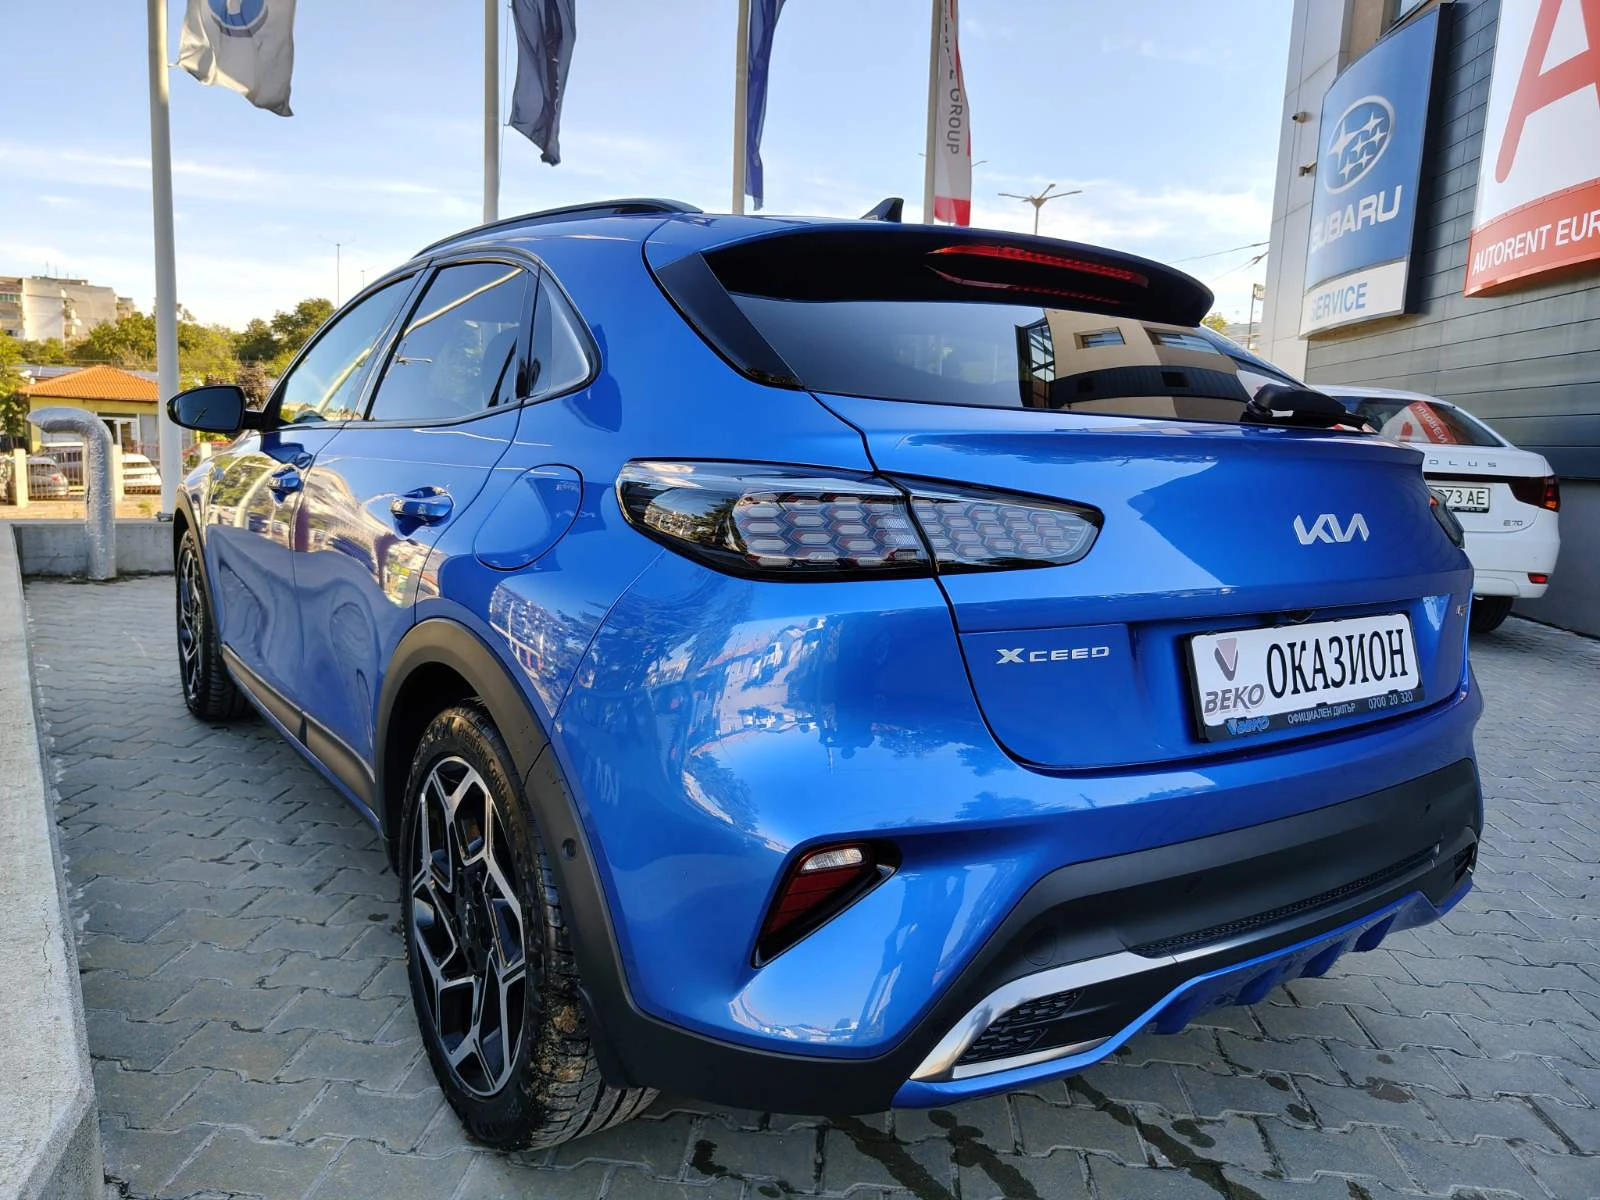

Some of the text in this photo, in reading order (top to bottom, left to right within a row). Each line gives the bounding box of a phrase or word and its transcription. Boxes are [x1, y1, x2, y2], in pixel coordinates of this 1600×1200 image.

[946, 88, 963, 155] GROUP
[1310, 185, 1402, 251] SUBARU
[1472, 209, 1600, 275] AUTORENT EUR
[1437, 489, 1486, 505] 73 AE
[1293, 513, 1370, 545] KIA
[996, 646, 1110, 665] XCEED
[1266, 628, 1409, 699] ОКАЗИОН
[1287, 707, 1332, 724] ОФИЦИАЛЕН
[1368, 697, 1387, 710] 0700
[1389, 695, 1399, 706] 20
[1401, 691, 1413, 703] 320
